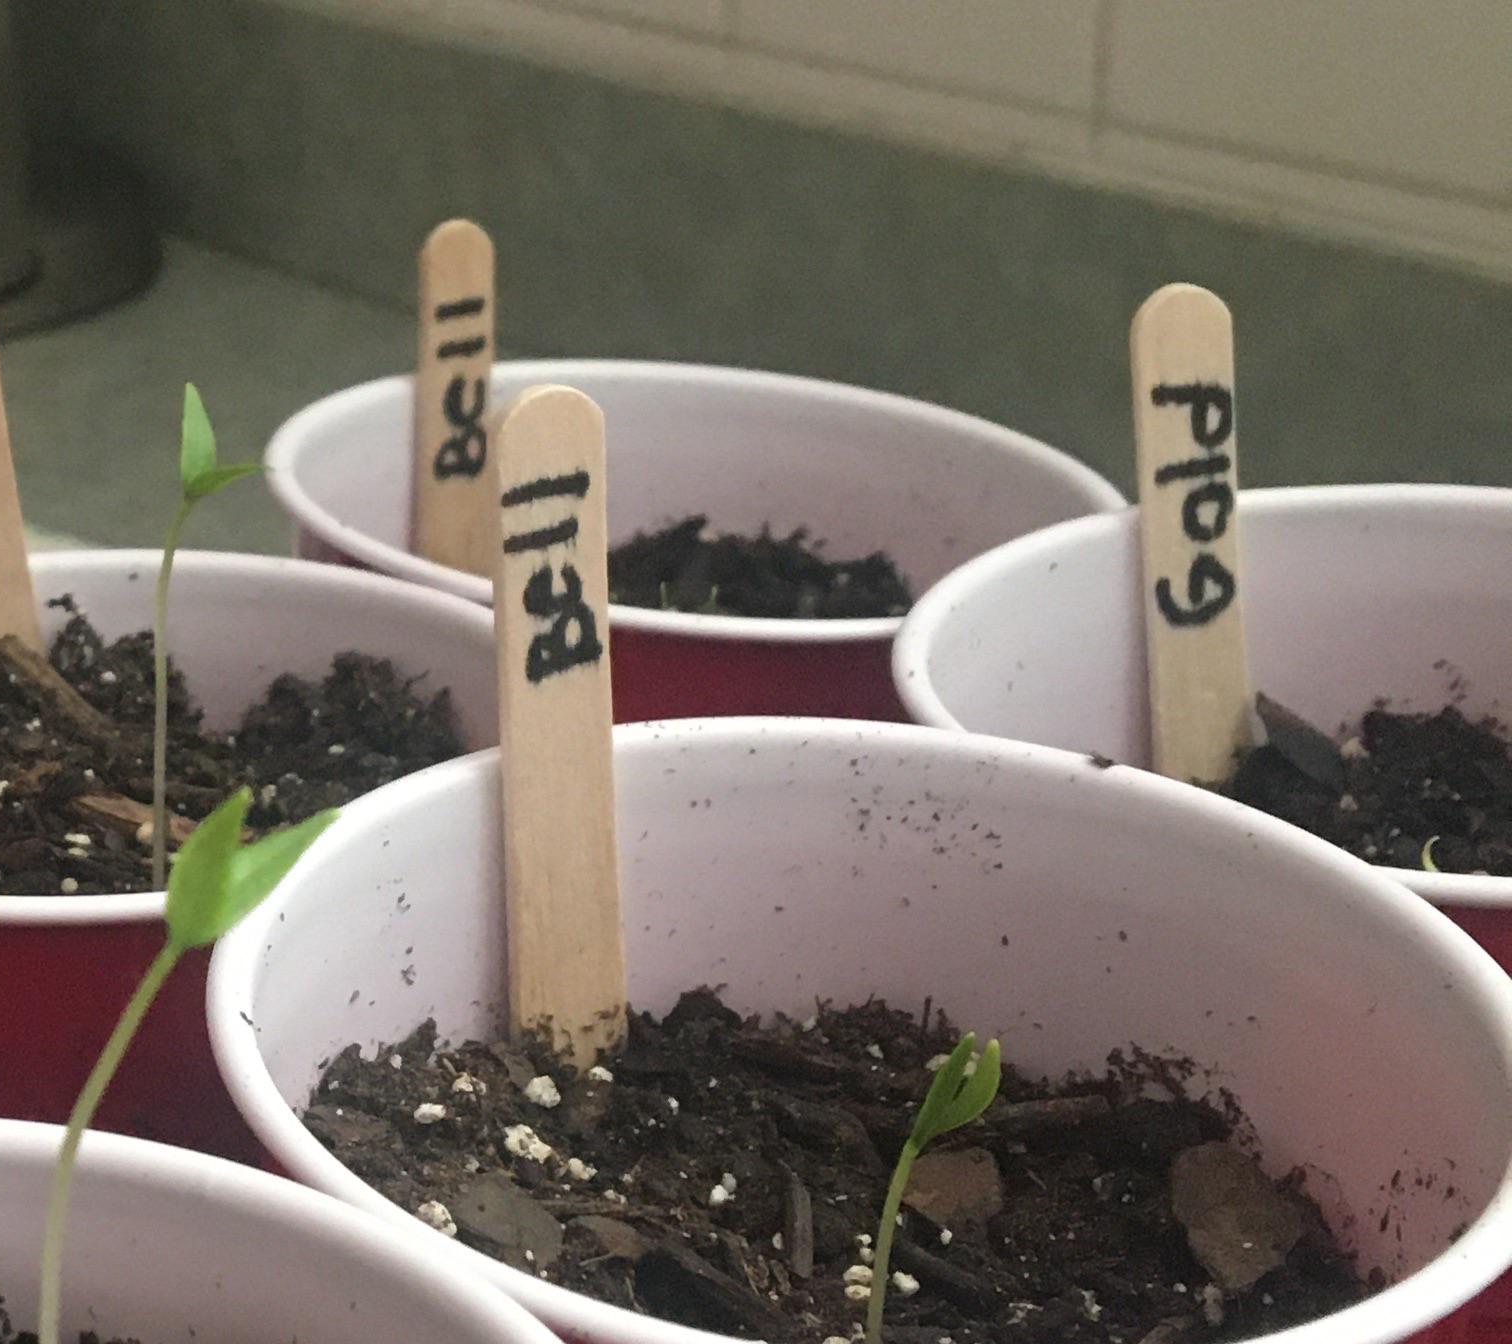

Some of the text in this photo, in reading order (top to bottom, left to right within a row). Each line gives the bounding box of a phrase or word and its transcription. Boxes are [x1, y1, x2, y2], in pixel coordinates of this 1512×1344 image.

[434, 297, 487, 481] Bell
[501, 470, 603, 684] Bell
[1151, 381, 1236, 628] Gold
